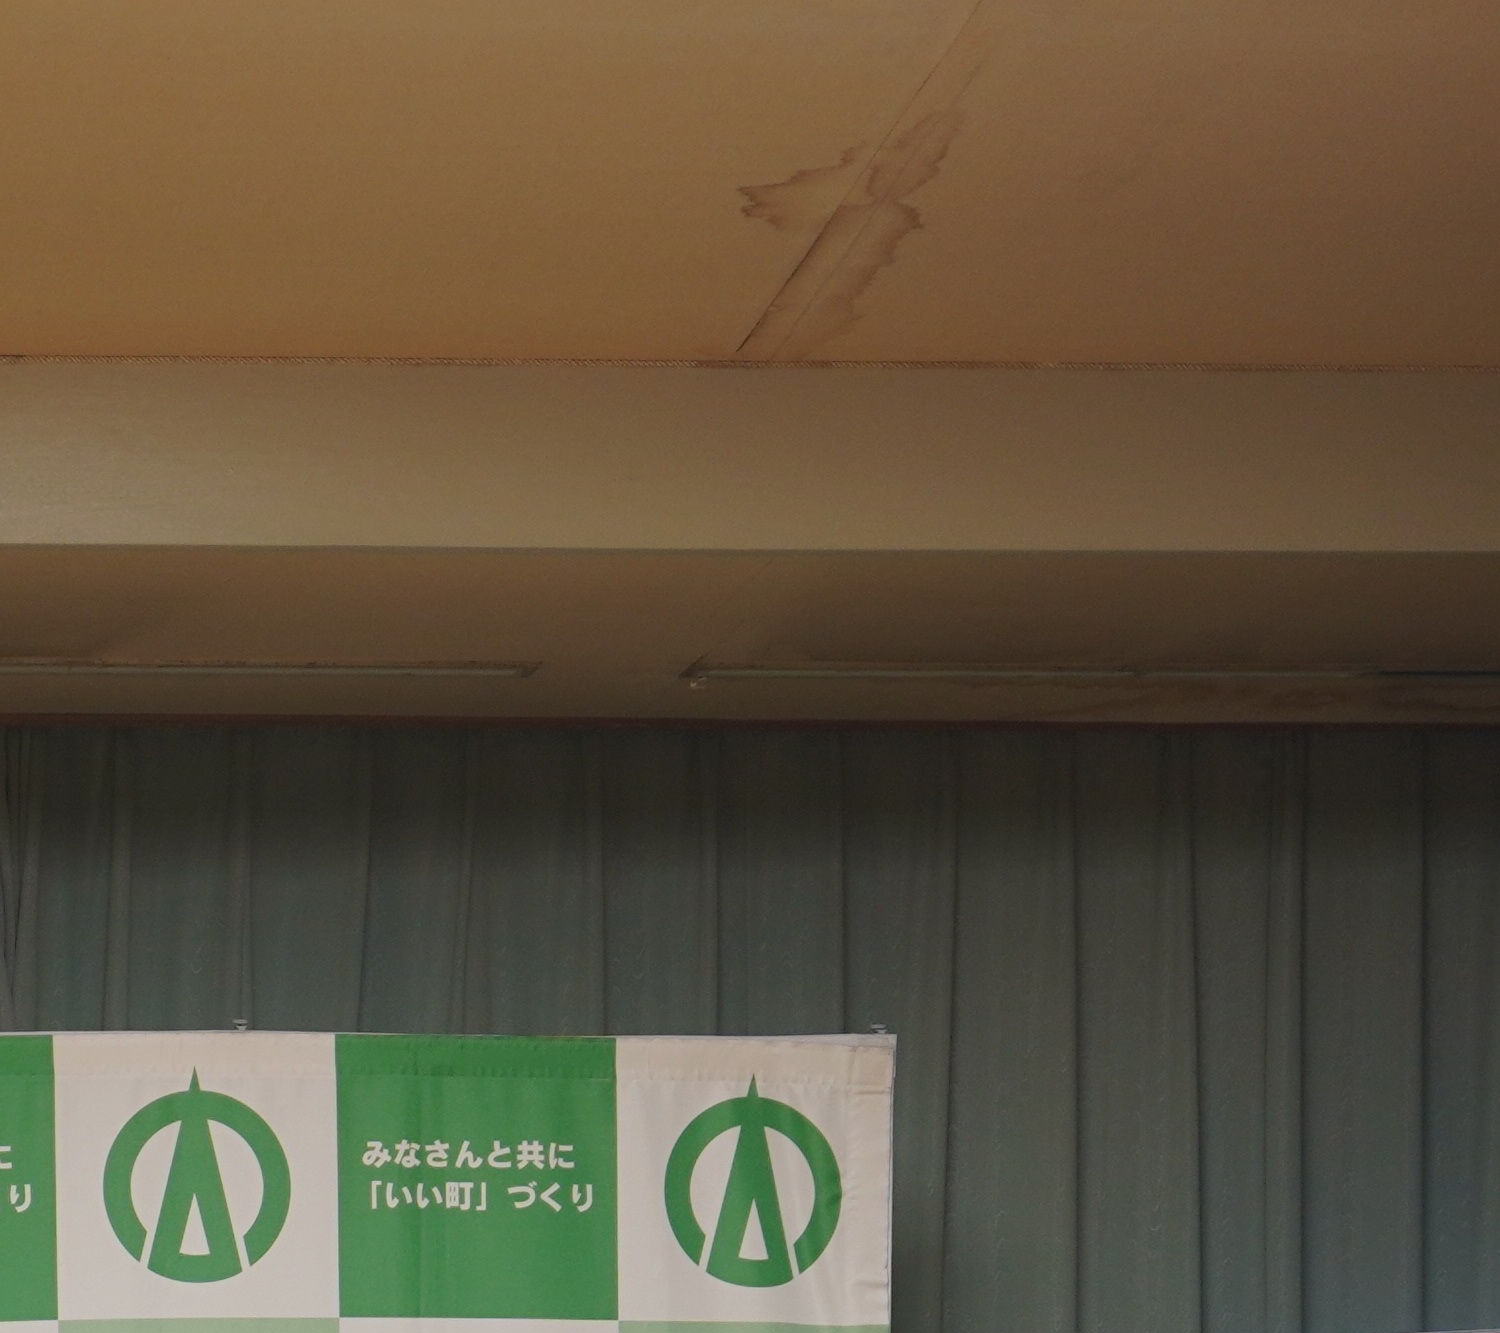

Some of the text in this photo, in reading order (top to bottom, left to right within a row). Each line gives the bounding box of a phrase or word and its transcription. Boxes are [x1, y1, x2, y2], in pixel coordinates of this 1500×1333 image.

[361, 1139, 575, 1170] みなさんと共に
